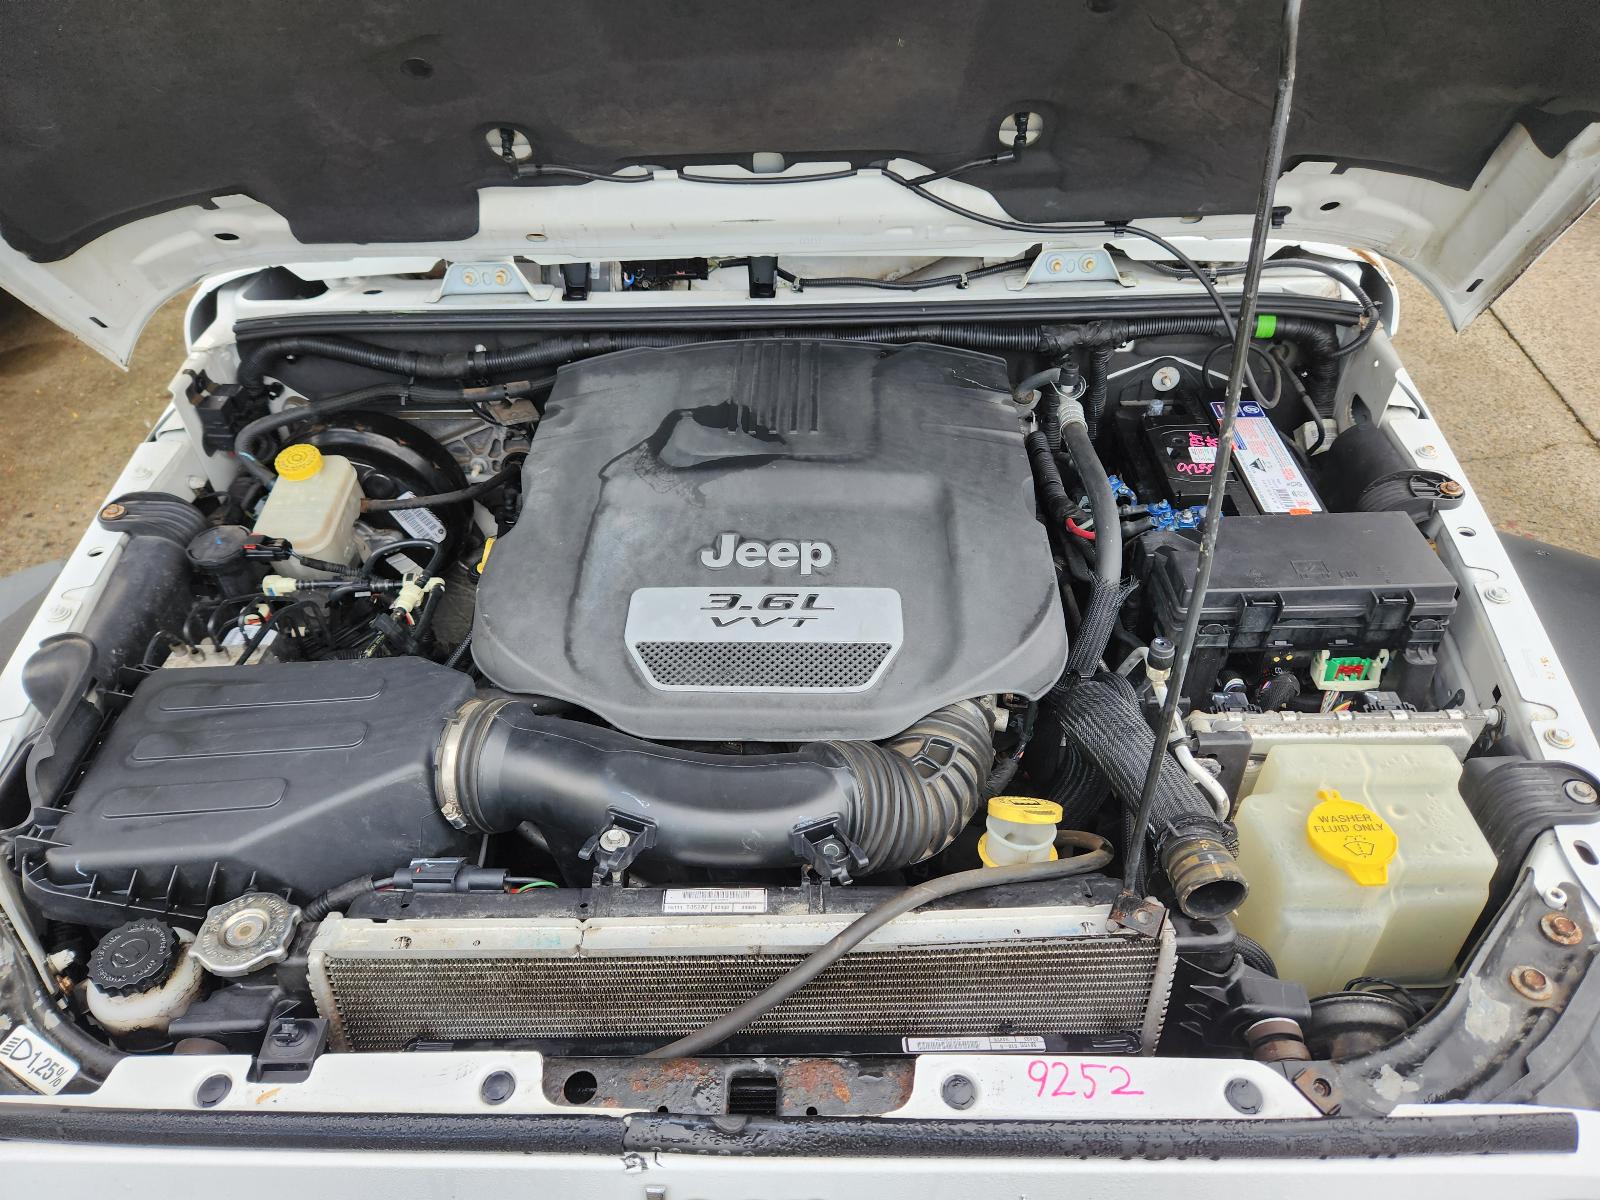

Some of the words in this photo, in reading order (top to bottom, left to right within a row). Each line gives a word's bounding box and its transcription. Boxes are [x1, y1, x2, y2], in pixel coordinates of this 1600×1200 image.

[700, 533, 833, 575] Jeep
[700, 593, 835, 610] 3.6L
[710, 616, 819, 628] VVT
[1317, 813, 1372, 823] WASHER
[1313, 824, 1350, 833] FLUID
[1353, 823, 1384, 832] ONLY
[27, 1051, 69, 1088] 1,25%
[1028, 1060, 1145, 1099] 9252
